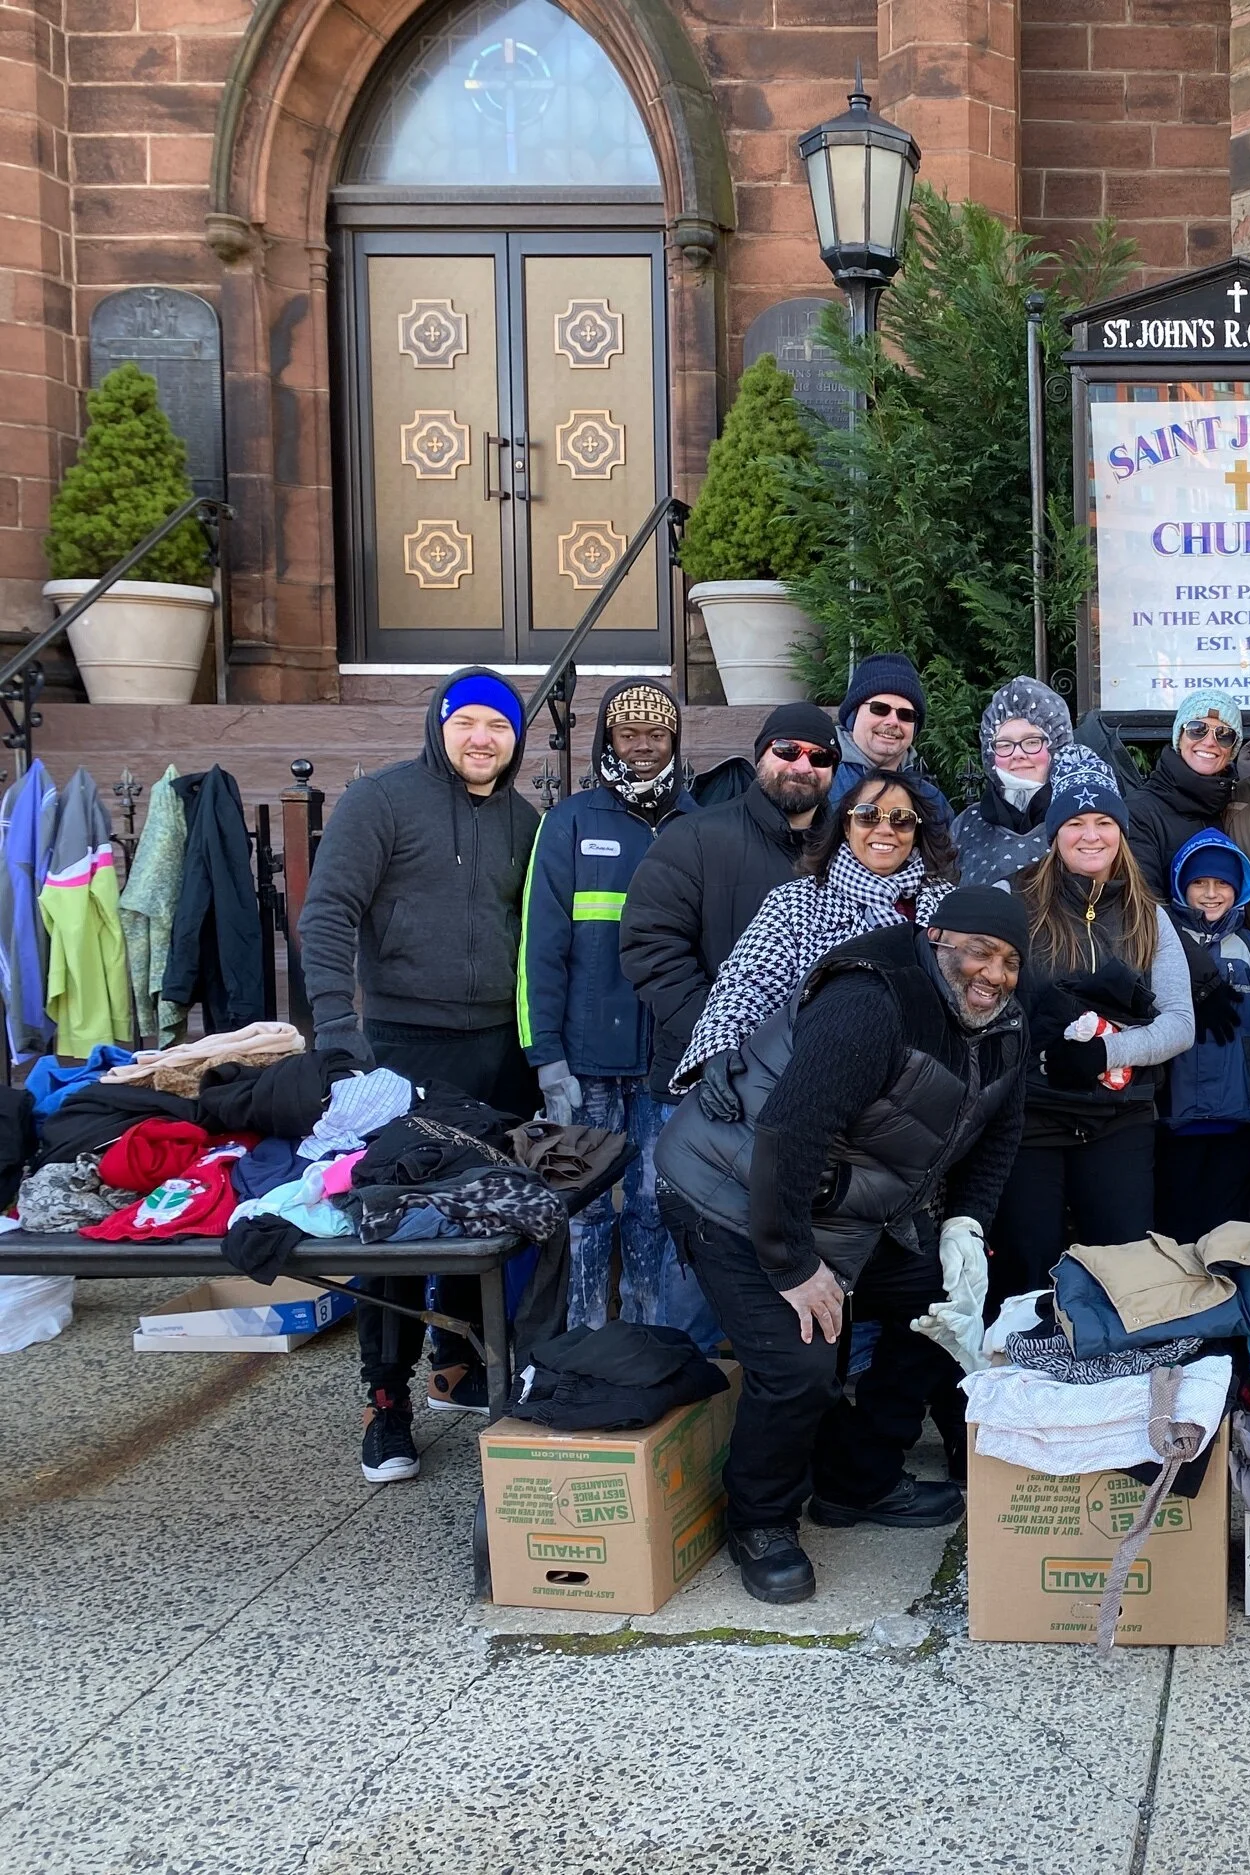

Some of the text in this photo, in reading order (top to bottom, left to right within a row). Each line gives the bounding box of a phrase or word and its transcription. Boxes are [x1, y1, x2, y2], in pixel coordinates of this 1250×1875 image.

[1108, 416, 1221, 483] SAINT
[1175, 584, 1233, 600] FIRST
[1132, 611, 1154, 626] IN
[1159, 610, 1200, 626] THE
[1197, 636, 1236, 650] EST.
[1151, 678, 1177, 688] FR.
[606, 711, 670, 727] FENDI
[531, 1450, 590, 1459] uhaul.com
[1016, 1484, 1025, 1492] in
[1044, 1485, 1060, 1493] You
[1062, 1485, 1080, 1494] Give
[573, 1488, 626, 1502] BEST PRICE
[1034, 1495, 1052, 1503] and
[1054, 1495, 1081, 1504] Prices
[1110, 1490, 1146, 1505] PRICE
[575, 1505, 628, 1523] SAVE!
[1010, 1504, 1081, 1514] Beat Our Bundle
[997, 1514, 1080, 1525] SAVE EVEN MORE!
[1111, 1508, 1183, 1532] SAE!
[1053, 1527, 1060, 1535] A
[532, 1543, 601, 1560] U-HAUL
[1049, 1571, 1144, 1588] UHAUL
[532, 1587, 615, 1598] EASY-TO-LIFT HANDLES
[1050, 1623, 1087, 1631] HANDLES
